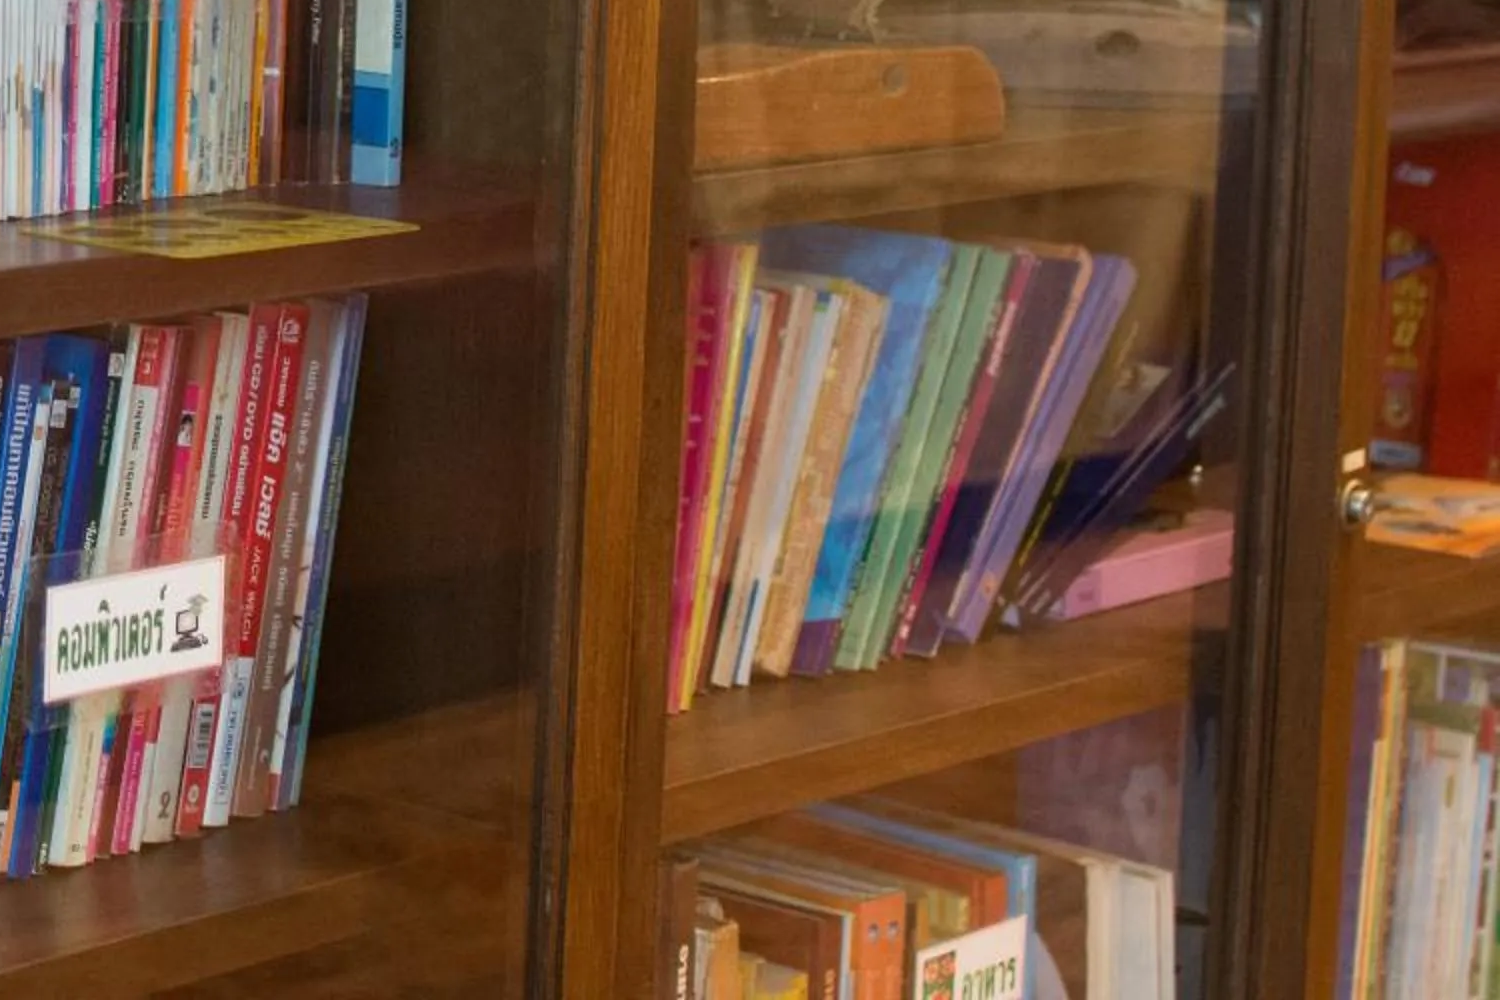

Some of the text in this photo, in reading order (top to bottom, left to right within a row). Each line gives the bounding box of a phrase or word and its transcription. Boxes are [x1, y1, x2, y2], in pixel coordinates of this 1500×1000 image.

[267, 411, 289, 463] แจ็ค
[248, 545, 263, 587] JACK
[56, 584, 168, 675] คอมพิวเตอร์
[240, 590, 256, 643] WELCH
[962, 957, 1017, 1000] อาหาร
